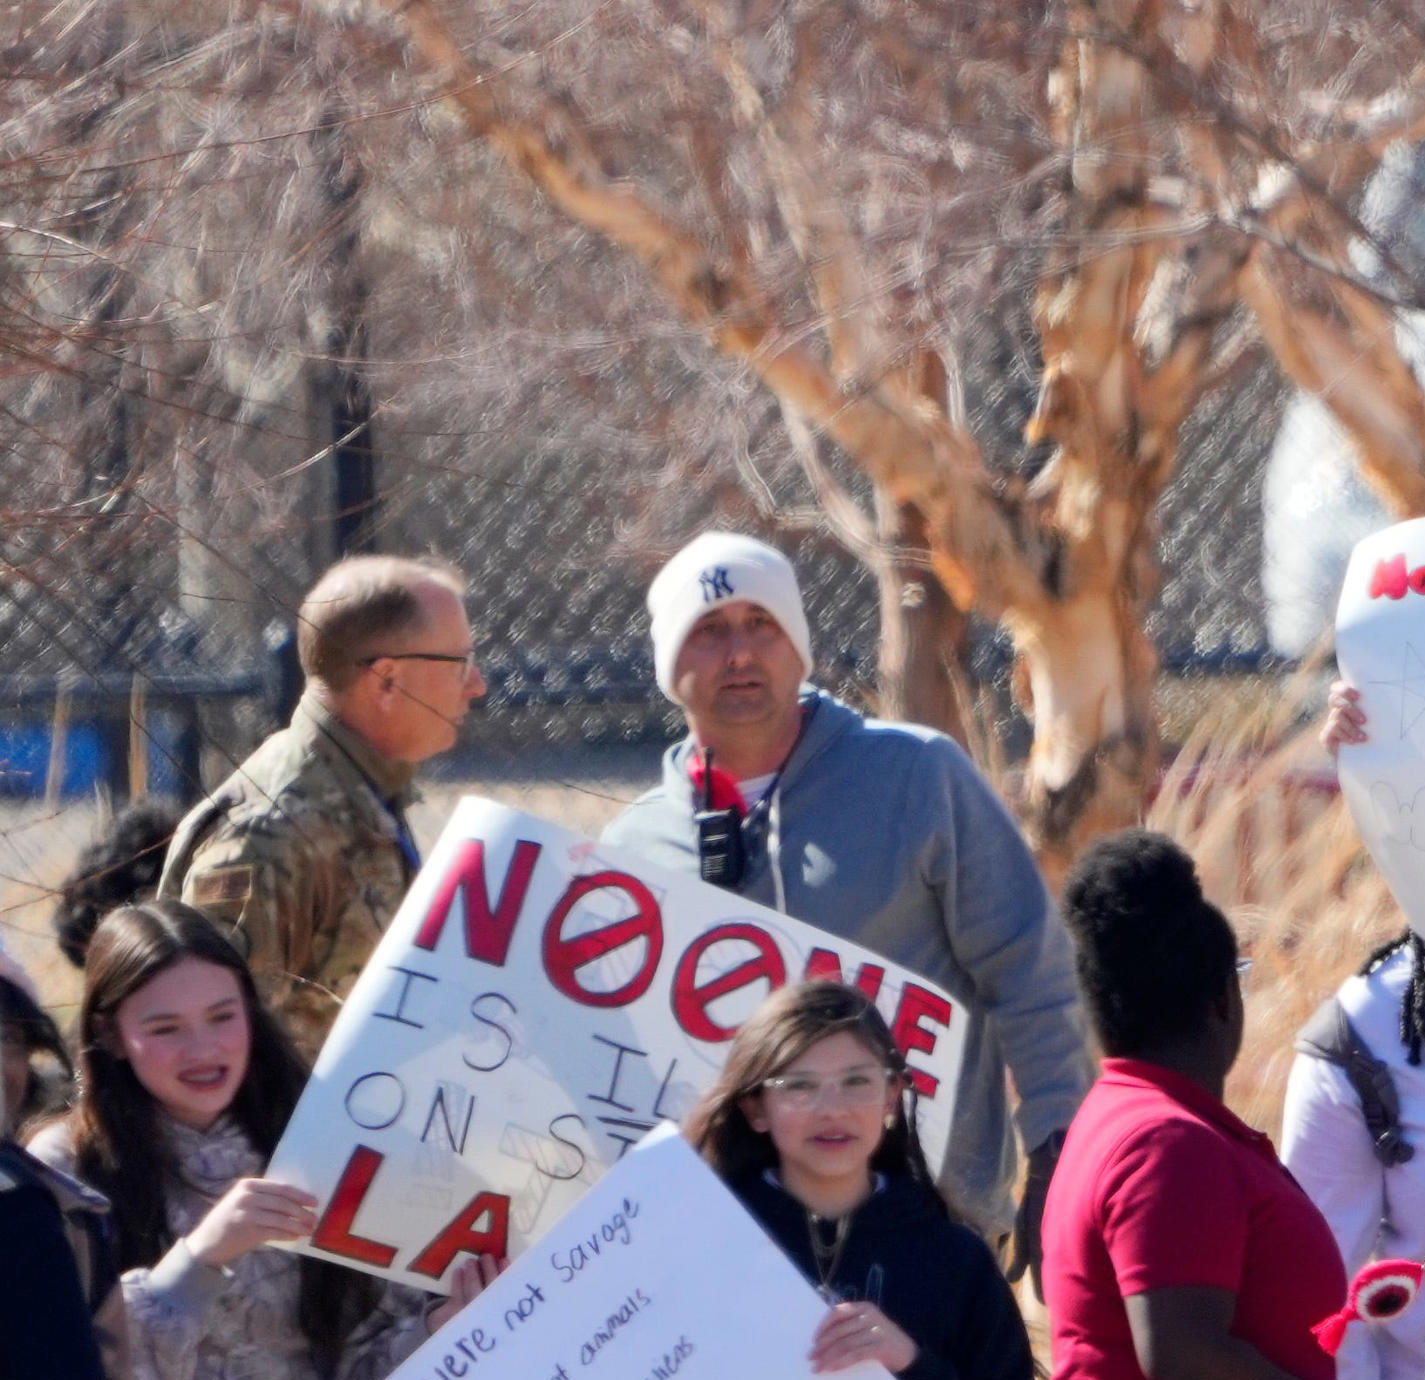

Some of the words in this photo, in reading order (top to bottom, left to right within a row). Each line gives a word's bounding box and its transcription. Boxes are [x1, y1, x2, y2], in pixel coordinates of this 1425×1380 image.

[699, 566, 735, 603] NY
[372, 964, 520, 1073] IS
[343, 1070, 477, 1157] ON
[312, 1143, 511, 1281] LA
[503, 1283, 545, 1333] not
[579, 1288, 653, 1366] animals
